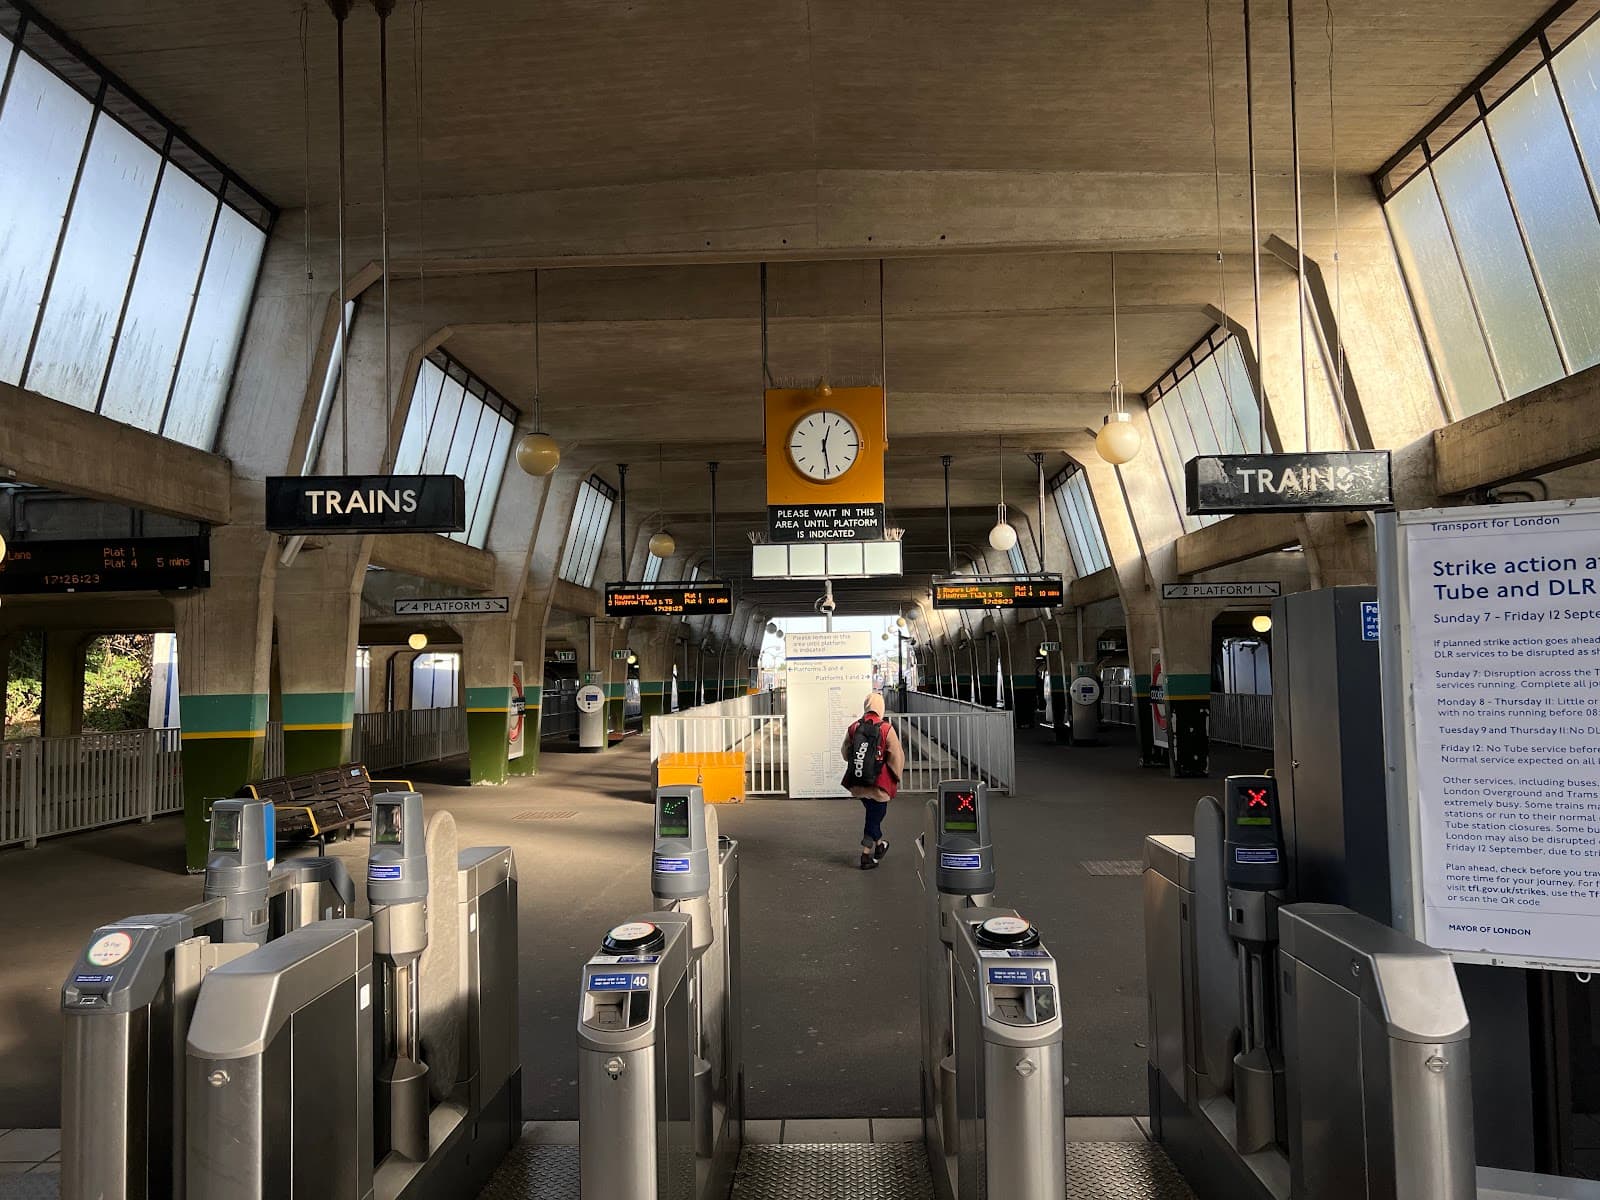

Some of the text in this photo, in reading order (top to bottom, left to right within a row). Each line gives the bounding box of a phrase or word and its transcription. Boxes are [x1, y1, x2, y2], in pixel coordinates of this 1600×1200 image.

[1236, 467, 1351, 493] TRAINS
[305, 490, 417, 515] TRAINS
[777, 510, 809, 518] PLEASE
[814, 509, 837, 517] WAIT
[1432, 517, 1560, 532] Transport for London
[104, 548, 125, 557] Plat
[105, 558, 190, 568] Plat 4 5 mins
[1433, 560, 1496, 576] Strike
[1505, 557, 1576, 573] action
[1183, 585, 1188, 594] 2
[1194, 585, 1254, 594] PLATFORM
[1434, 579, 1597, 600] Tube and DLR
[424, 602, 479, 611] PLATFORM
[1434, 614, 1480, 624] Sunday
[1505, 611, 1544, 622] Friday
[1550, 610, 1560, 619] 12
[1443, 639, 1480, 648] planned
[1527, 648, 1574, 657] disrupted
[1436, 671, 1470, 679] Sunday
[1484, 670, 1536, 678] Disruption
[1521, 680, 1570, 688] Complete
[1494, 698, 1541, 707] Thursday
[1509, 709, 1546, 718] running
[1439, 727, 1479, 735] Tuesday
[1510, 726, 1557, 735] Thursday
[1441, 745, 1470, 753] Friday
[854, 743, 868, 777] adidas
[1518, 757, 1563, 765] expected
[1519, 778, 1564, 787] including
[1483, 789, 1542, 797] Overground
[1546, 836, 1595, 845] disrupted
[1447, 844, 1475, 852] Friday
[1489, 845, 1545, 854] September,
[1468, 865, 1498, 873] ahead,
[1501, 866, 1527, 874] check
[1035, 971, 1046, 981] 41
[633, 977, 647, 986] 40
